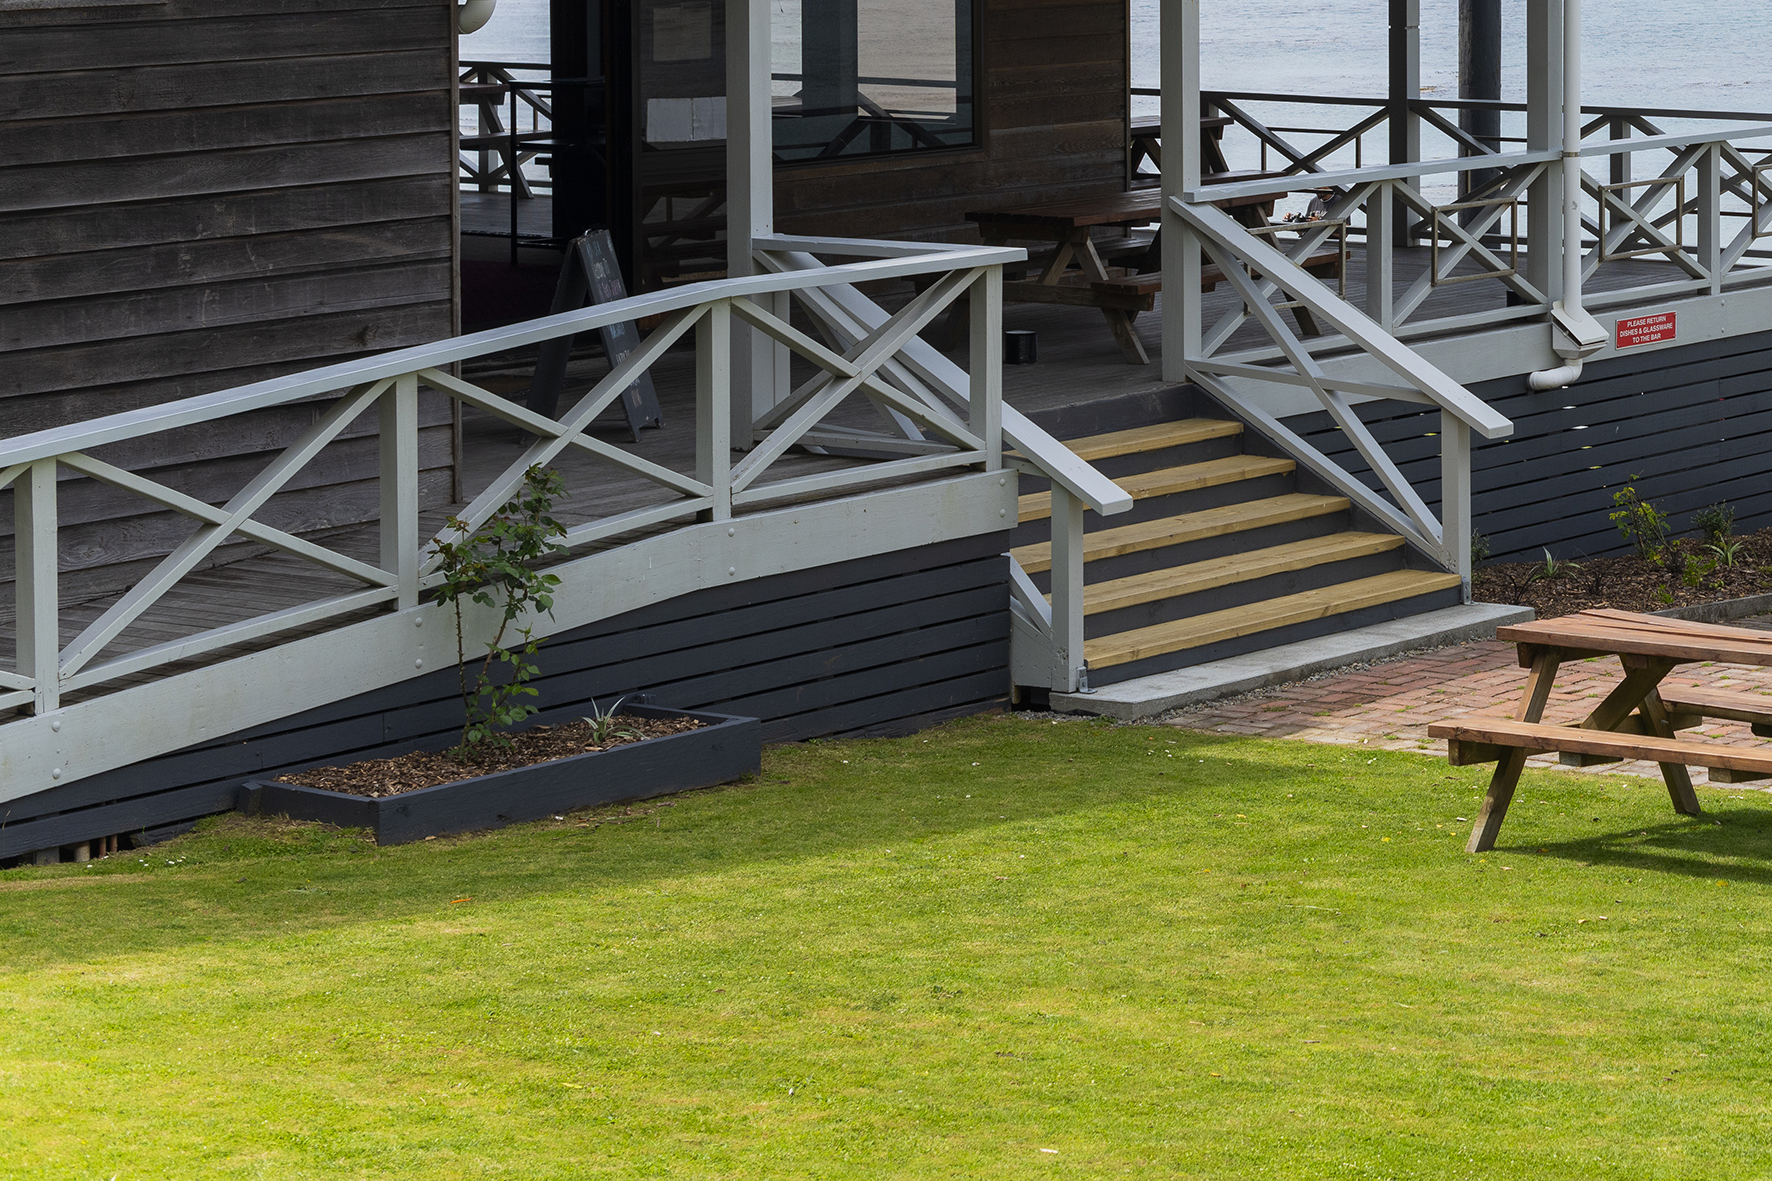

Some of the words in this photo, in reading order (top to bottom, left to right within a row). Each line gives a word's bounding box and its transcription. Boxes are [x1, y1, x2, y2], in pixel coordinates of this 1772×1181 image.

[1647, 316, 1666, 324] RETURN
[1619, 329, 1638, 337] DISHES
[1643, 323, 1673, 333] GLASSWARE
